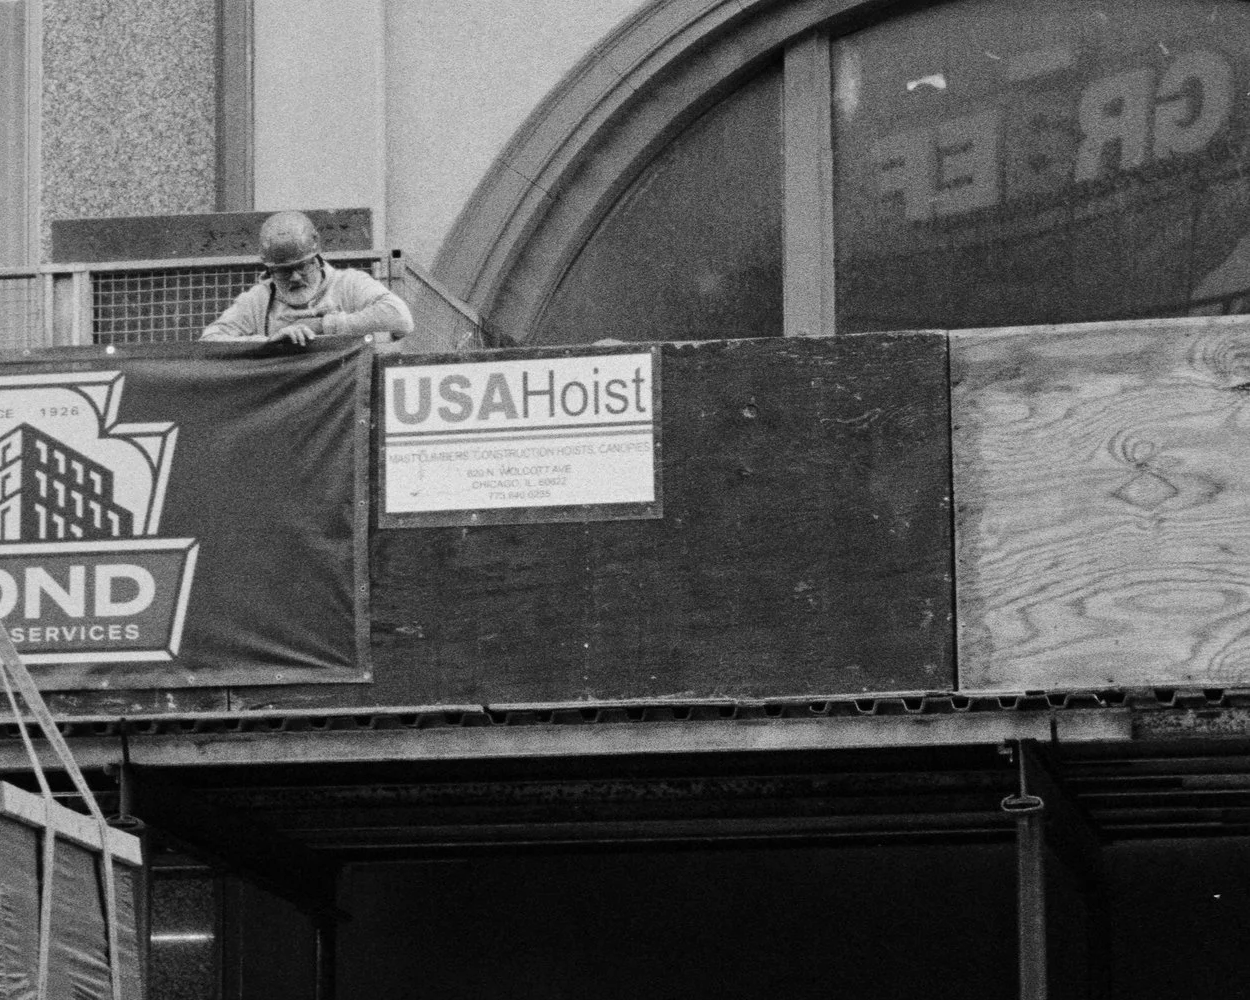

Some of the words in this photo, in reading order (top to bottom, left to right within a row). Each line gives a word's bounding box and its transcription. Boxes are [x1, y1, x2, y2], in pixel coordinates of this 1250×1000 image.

[393, 367, 646, 425] USAHoist
[39, 405, 80, 417] 1926
[598, 441, 651, 454] CANOPIES
[10, 624, 140, 643] SERVICES
